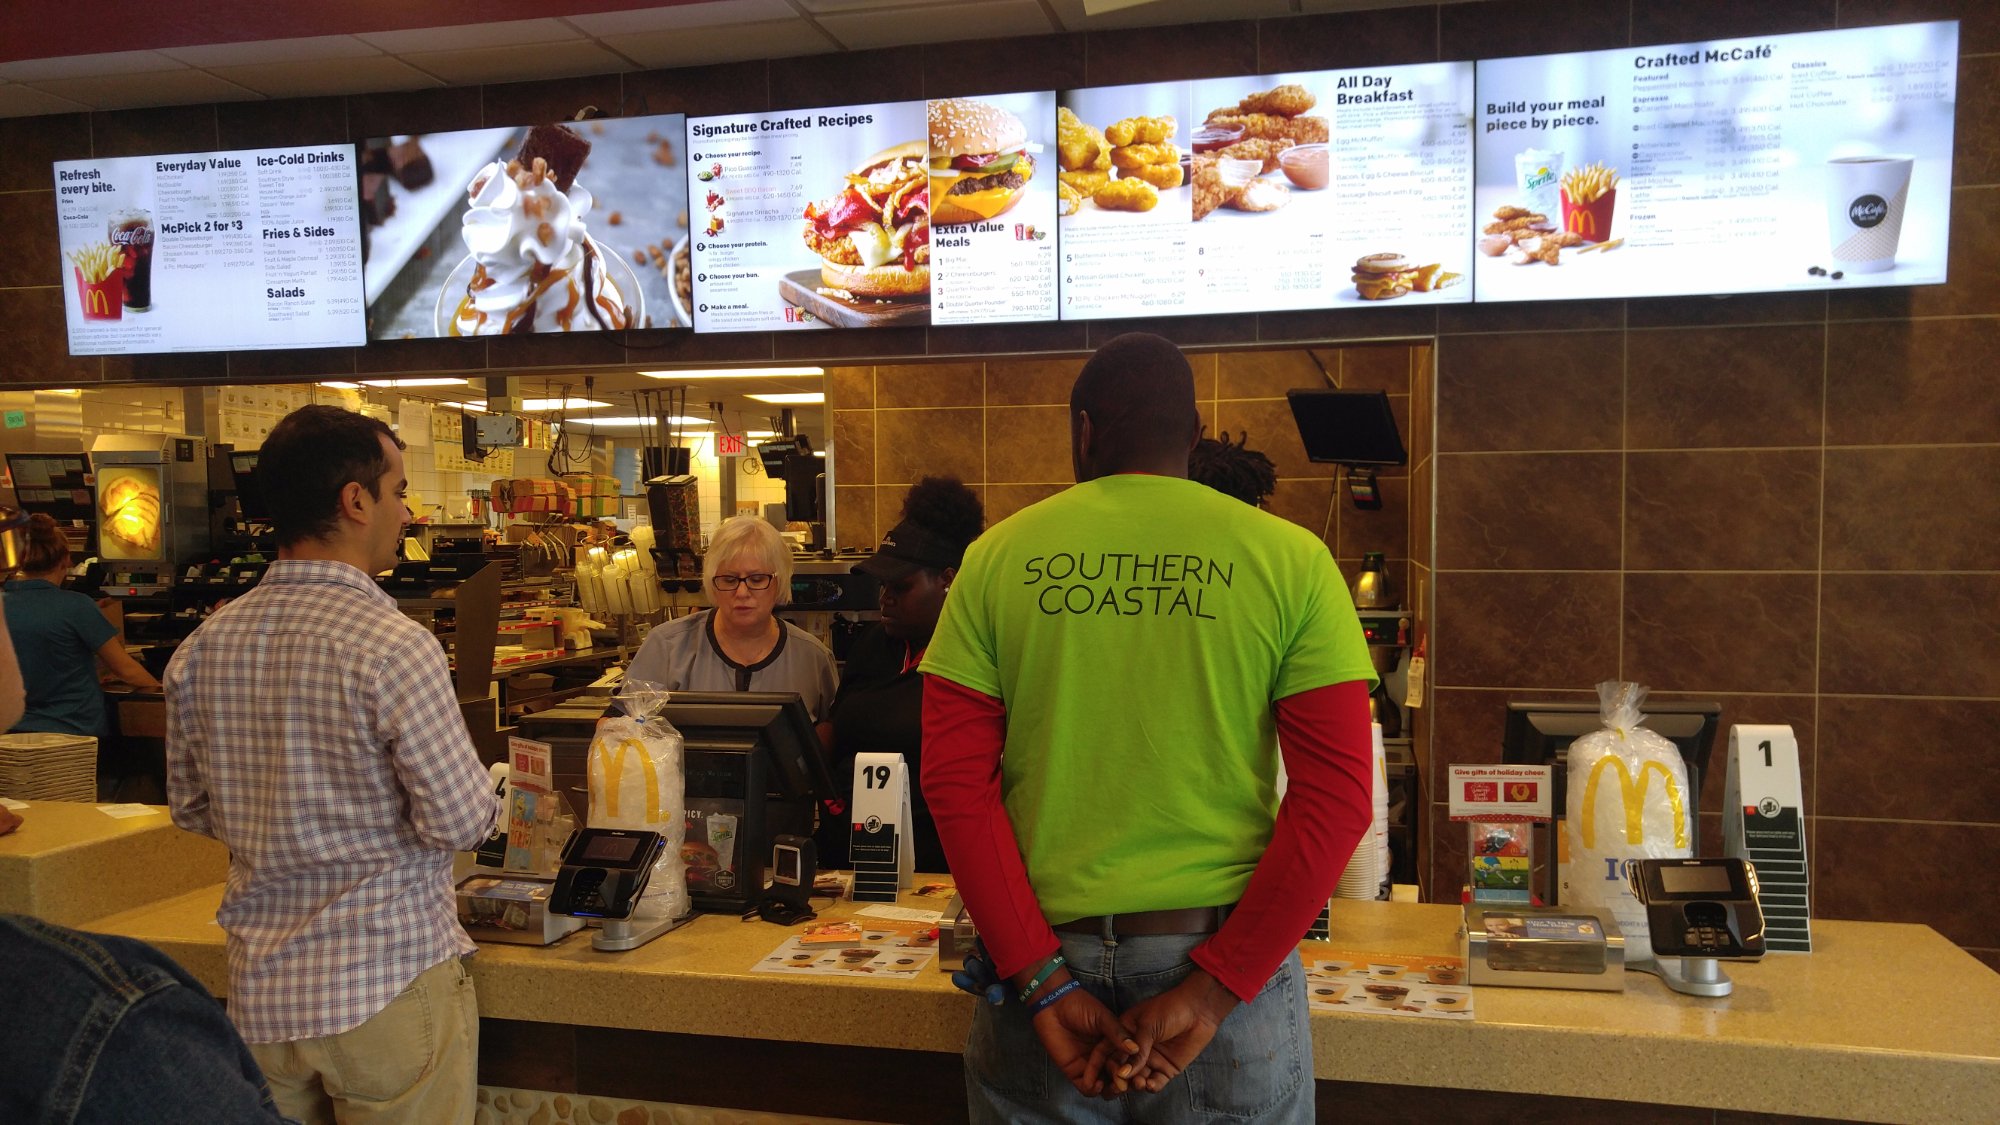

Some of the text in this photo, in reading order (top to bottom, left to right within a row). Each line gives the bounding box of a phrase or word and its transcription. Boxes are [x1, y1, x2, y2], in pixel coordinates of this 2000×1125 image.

[1634, 45, 1772, 69] Crafted McCafé
[1337, 76, 1392, 89] All Day
[1634, 74, 1669, 82] Featured
[1337, 90, 1413, 105] Breakfast
[1486, 97, 1606, 115] Build your meal
[693, 113, 873, 138] Signature Crafted Recipes
[1486, 115, 1598, 133] piece by piece.
[156, 158, 241, 172] Everyday Value
[257, 152, 344, 166] Ice-Cold Drinks
[60, 169, 100, 181] Refresh
[1527, 172, 1555, 190] Sprite
[61, 182, 116, 195] every bite.
[161, 220, 243, 233] McPick 2 for $3
[263, 226, 335, 239] Fries & Sides
[936, 222, 1004, 234] Extra Value
[936, 237, 970, 248] Meals
[1067, 254, 1072, 262] 5
[1199, 269, 1204, 277] 9
[1067, 276, 1072, 284] 6
[267, 287, 305, 298] Salads
[1067, 297, 1072, 305] 7
[719, 436, 742, 453] EXIT
[1024, 552, 1234, 589] SOUTHERN
[1038, 584, 1216, 619] COASTAL
[1757, 740, 1773, 767] 1
[862, 765, 891, 789] 19
